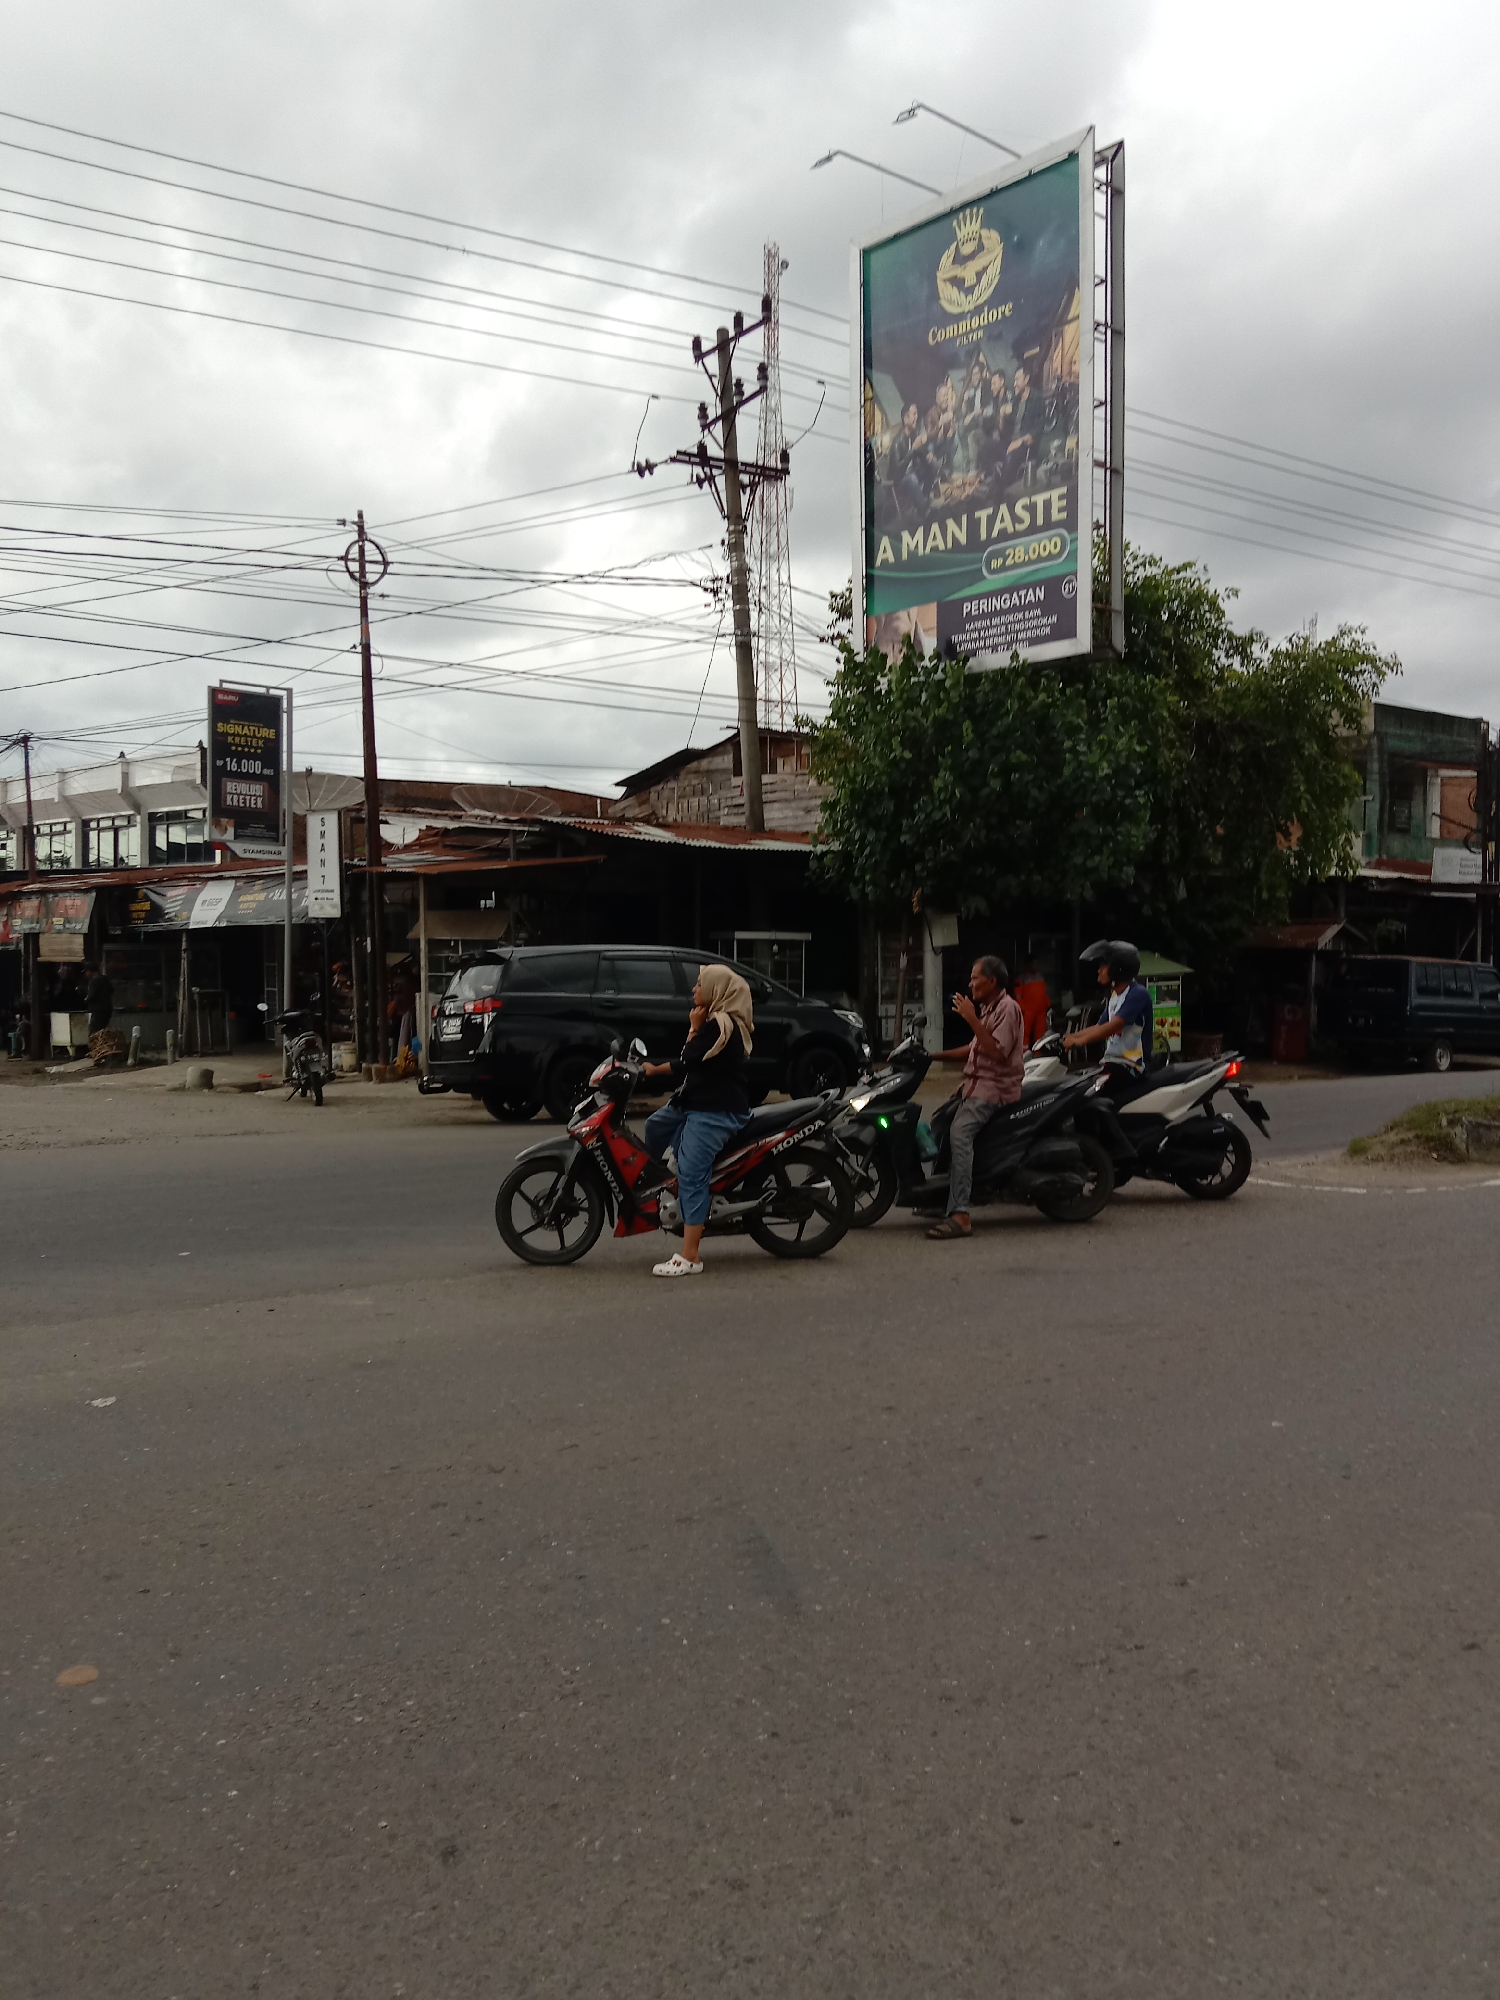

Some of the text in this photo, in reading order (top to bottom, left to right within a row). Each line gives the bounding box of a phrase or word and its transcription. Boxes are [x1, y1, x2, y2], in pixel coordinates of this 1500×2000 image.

[928, 301, 1013, 346] Commodore
[956, 329, 984, 347] FILTER
[875, 486, 1068, 567] A MAN TASTE
[1005, 536, 1061, 566] 28.000
[962, 585, 1045, 618] PERINGATAN
[216, 722, 276, 739] SIGNATURE
[227, 736, 264, 748] KRETEK
[225, 757, 262, 775] 16.000
[226, 781, 263, 797] REVOLUSI
[226, 794, 263, 809] KRETEK
[771, 1118, 826, 1156] HONDA
[593, 1149, 624, 1203] HONDA
